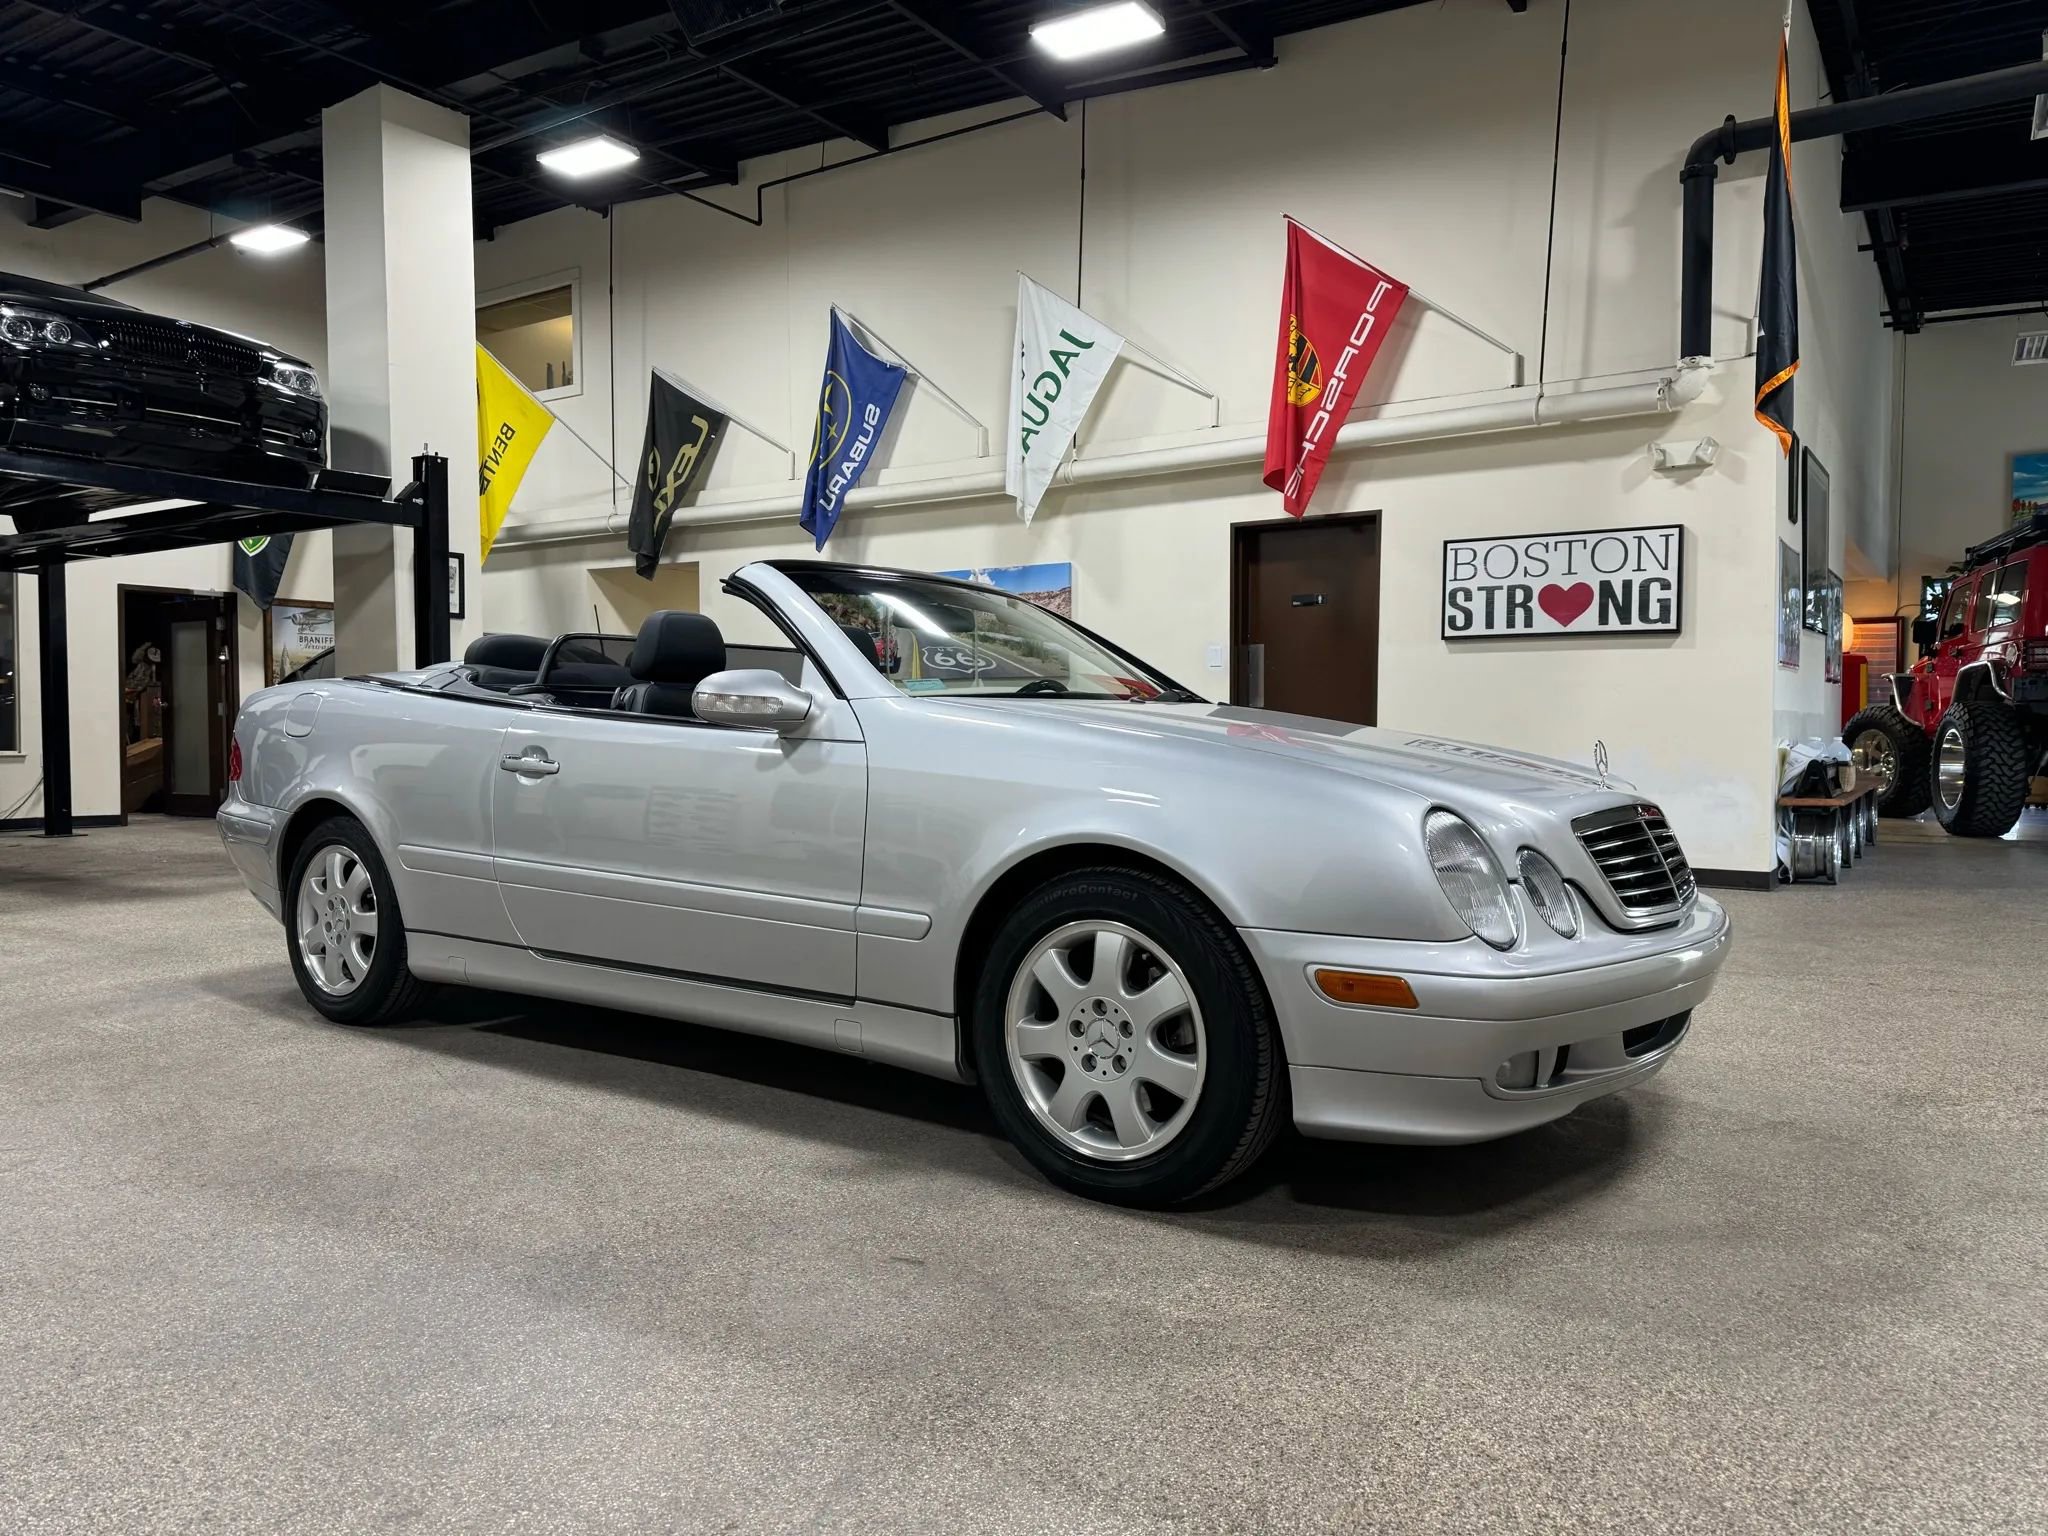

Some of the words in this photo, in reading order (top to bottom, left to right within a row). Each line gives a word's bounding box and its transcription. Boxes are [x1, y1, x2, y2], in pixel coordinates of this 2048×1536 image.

[1449, 533, 1675, 582] BOSTON
[1448, 577, 1672, 631] STRNG
[299, 635, 334, 645] BRANIFF
[934, 652, 986, 666] 66
